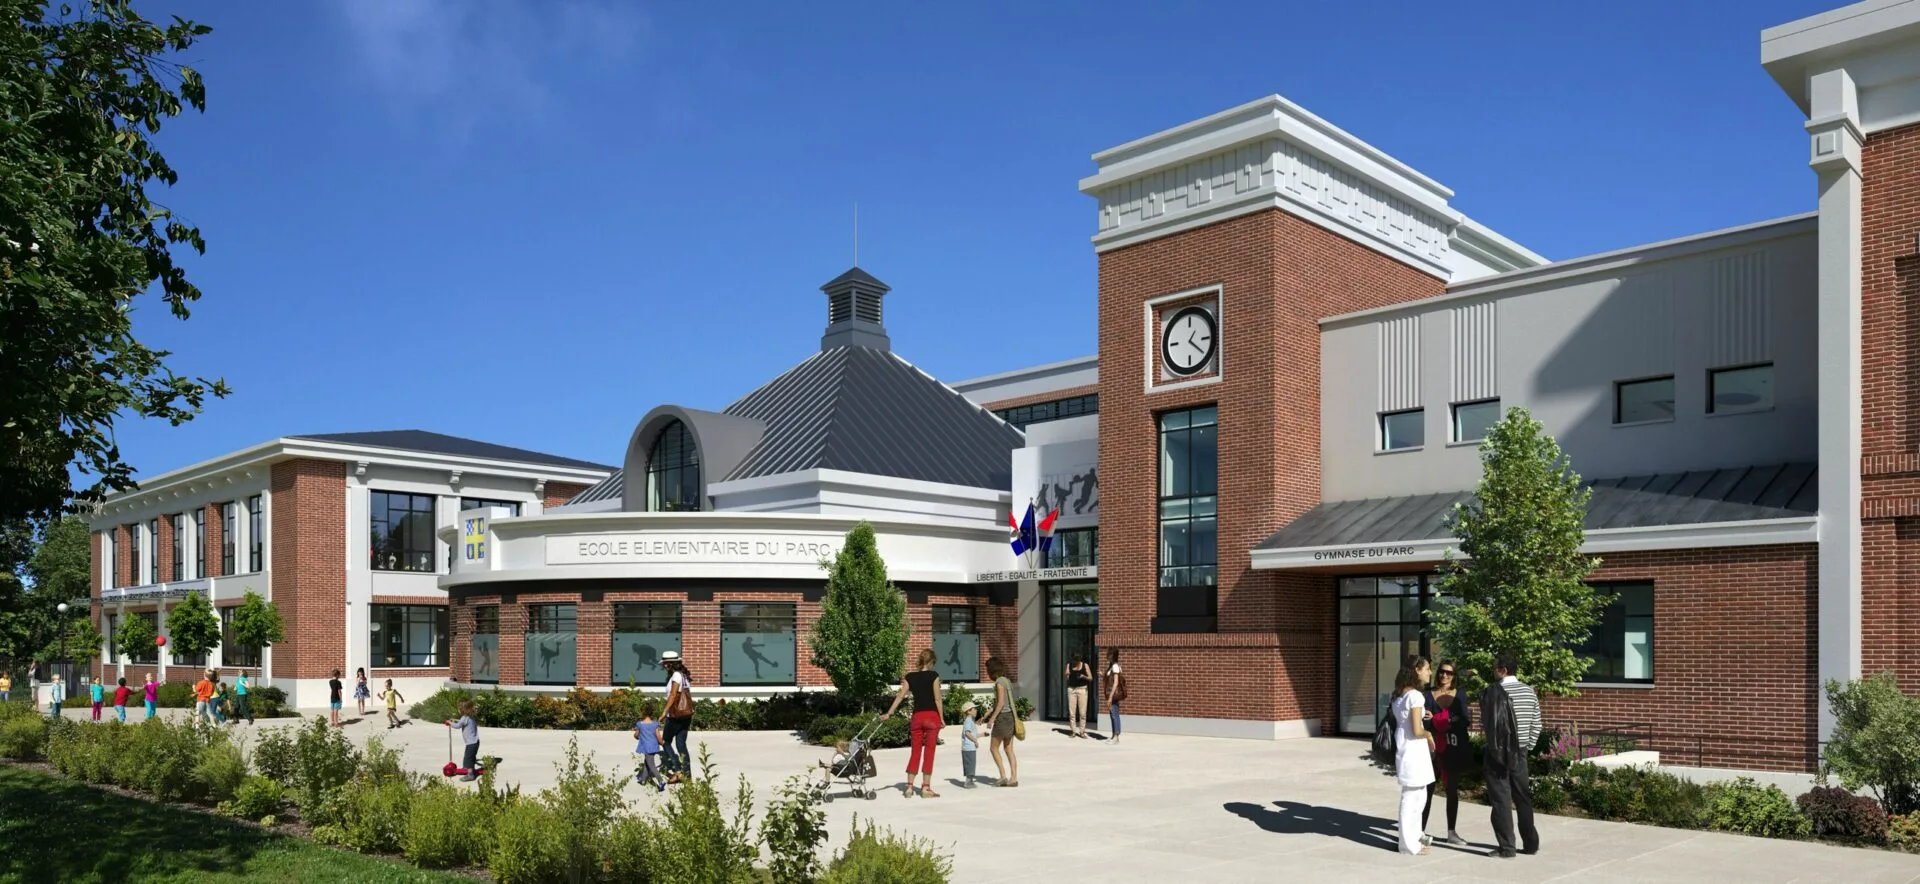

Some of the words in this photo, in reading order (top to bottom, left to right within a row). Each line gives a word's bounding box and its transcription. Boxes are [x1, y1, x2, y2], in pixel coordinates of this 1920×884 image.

[579, 542, 628, 555] ECOLE
[633, 541, 749, 555] ELEMENTAIRE
[755, 542, 779, 555] DU
[786, 542, 831, 556] PARC
[1314, 549, 1365, 560] GYMNASE
[1368, 549, 1383, 557] DU
[1386, 546, 1415, 556] PARC
[1044, 568, 1087, 578] FRATERNITÉ
